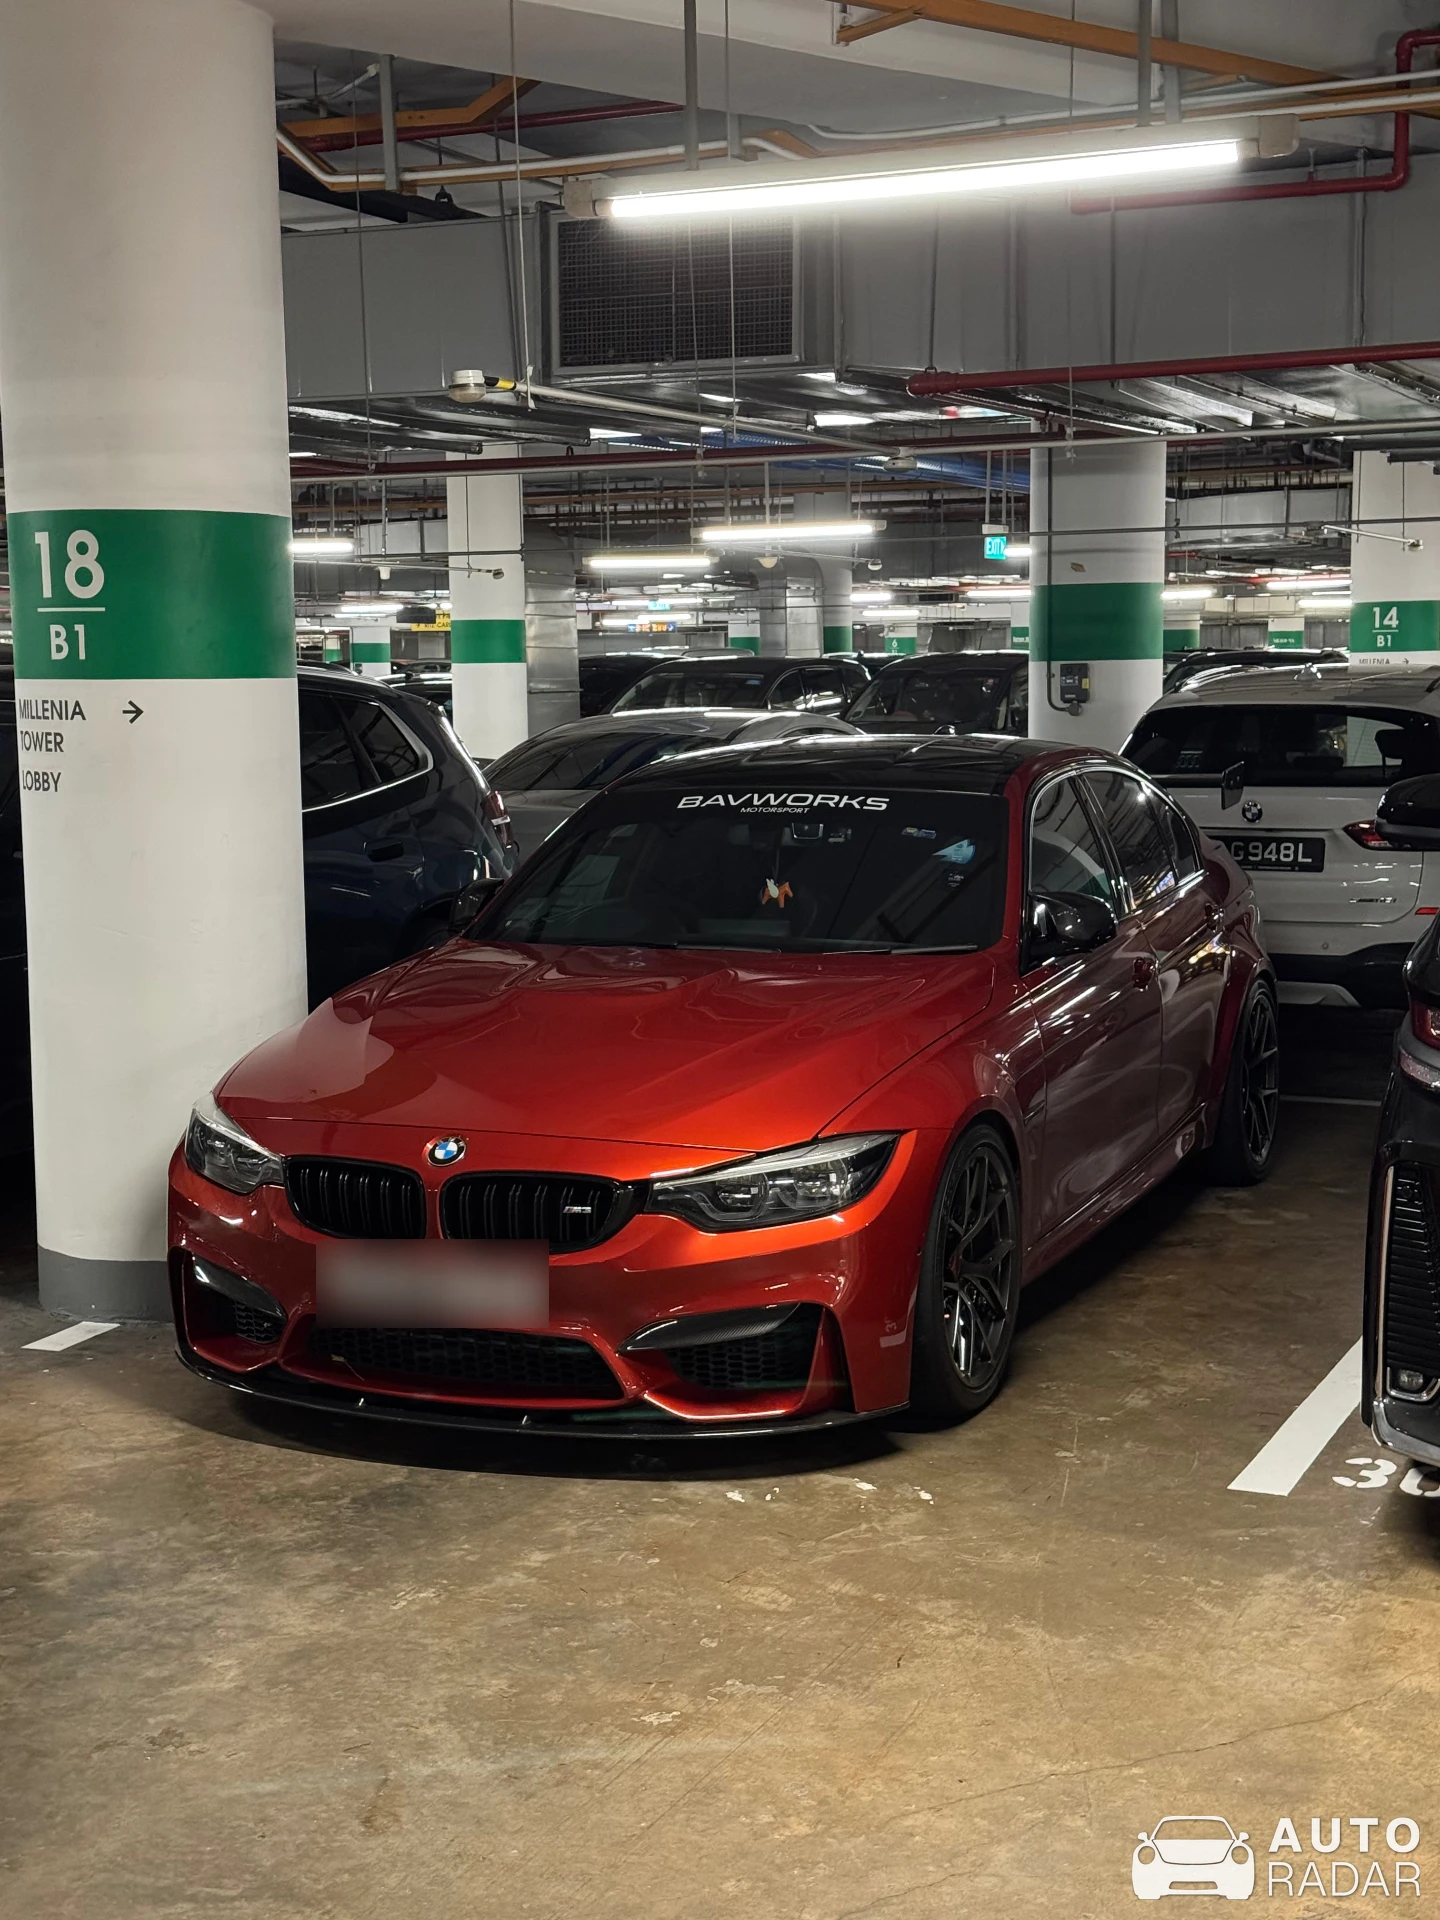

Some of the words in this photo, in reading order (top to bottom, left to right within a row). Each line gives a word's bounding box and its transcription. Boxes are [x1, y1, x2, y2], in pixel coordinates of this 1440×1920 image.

[34, 529, 105, 599] 18
[1372, 606, 1399, 628] 14
[50, 624, 86, 660] B1
[891, 638, 898, 648] 6
[1376, 634, 1391, 648] B1
[19, 698, 86, 721] MILLENIA
[20, 730, 64, 753] TOWER
[22, 770, 62, 792] LOBBY
[677, 793, 889, 811] BAVWORKS
